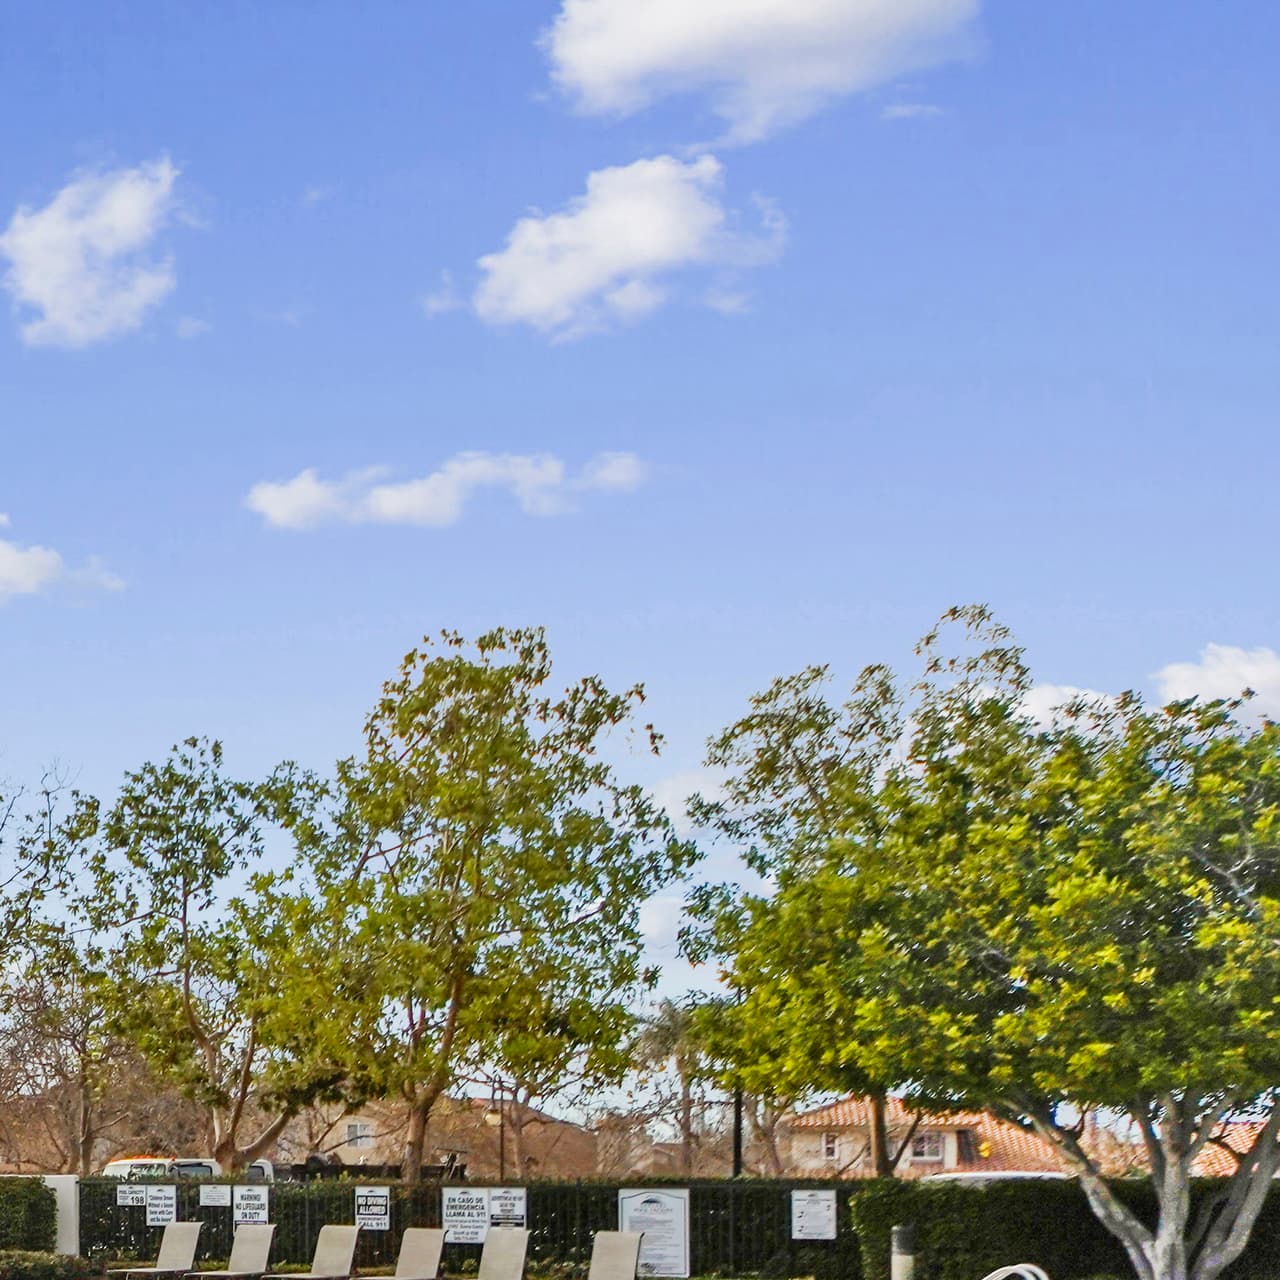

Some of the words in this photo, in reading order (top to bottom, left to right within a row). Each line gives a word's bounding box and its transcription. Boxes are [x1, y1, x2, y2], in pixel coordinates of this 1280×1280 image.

[131, 1196, 145, 1204] 198
[357, 1197, 366, 1205] NO
[367, 1197, 387, 1205] DIVING
[359, 1205, 386, 1214] ALLOWED
